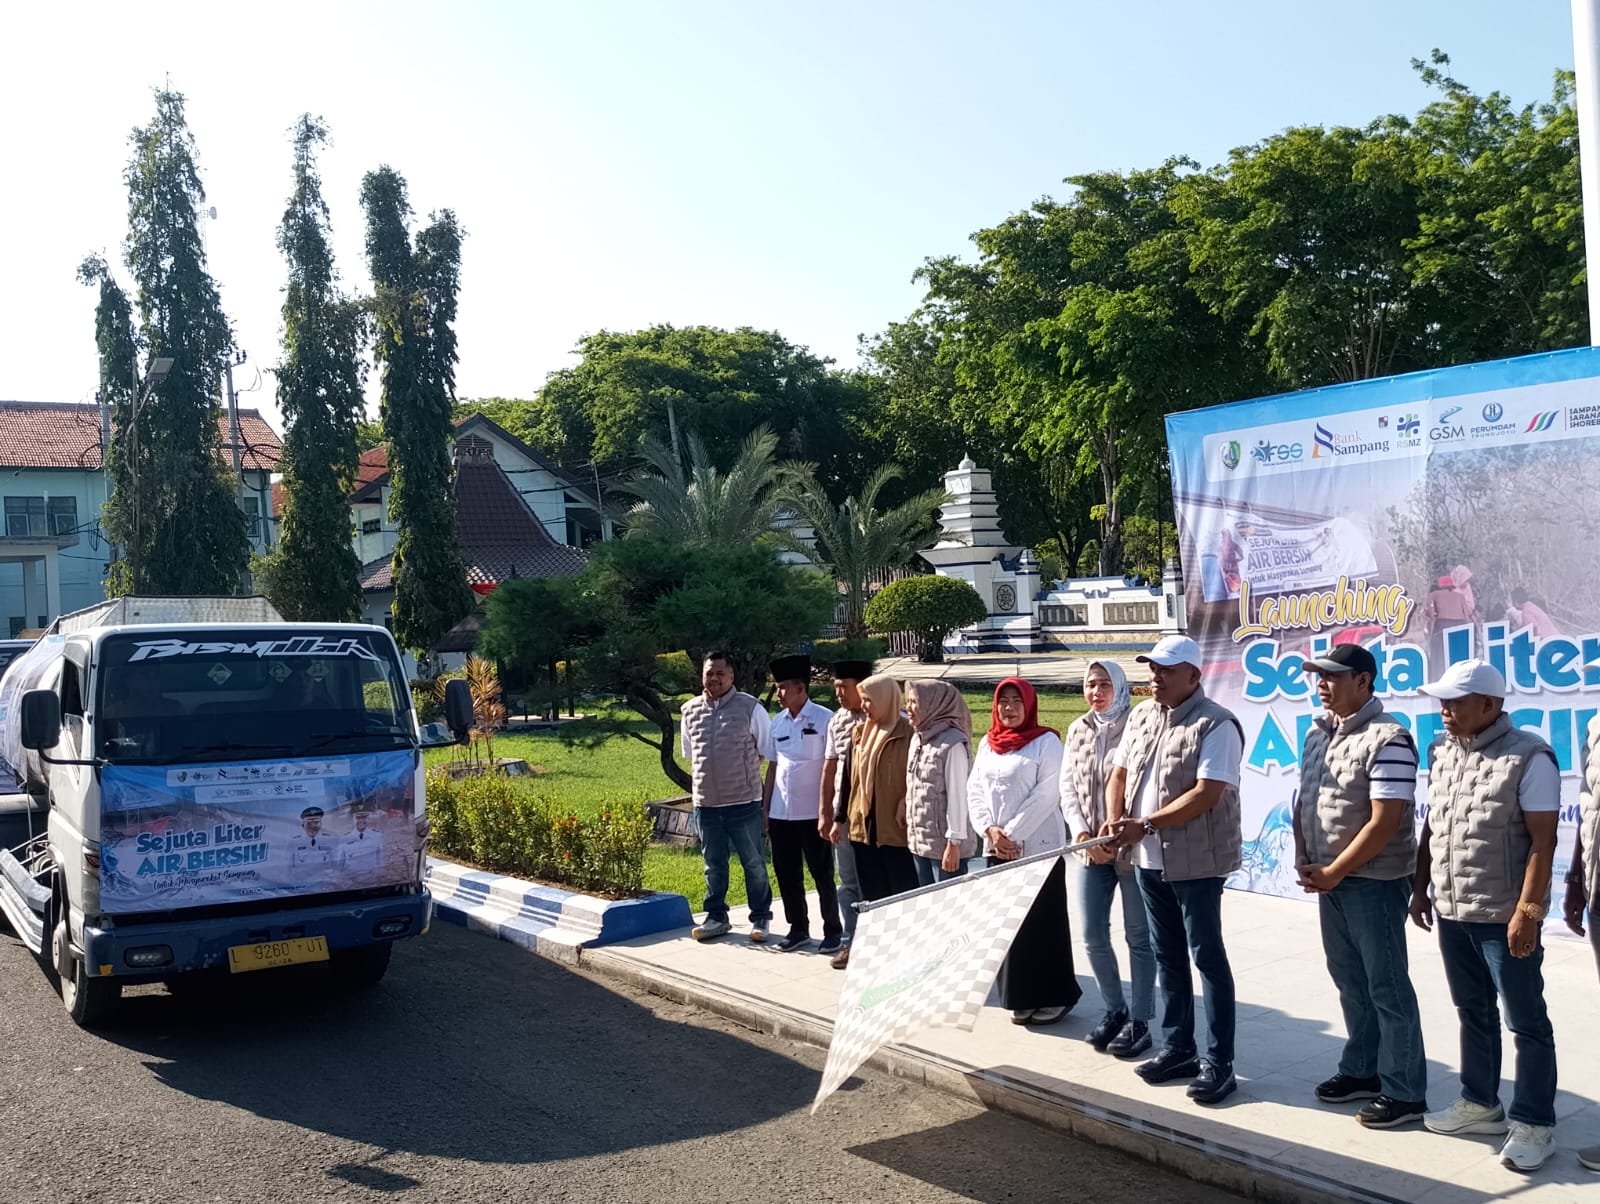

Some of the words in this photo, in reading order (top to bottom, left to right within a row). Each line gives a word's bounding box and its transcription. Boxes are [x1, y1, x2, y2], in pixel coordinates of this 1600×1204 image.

[1334, 430, 1362, 444] Bank
[1429, 424, 1465, 440] GSM
[1471, 423, 1516, 434] PERUMDAM
[1334, 440, 1390, 456] Sampang
[1397, 438, 1421, 449] RSMZ
[1247, 550, 1272, 571] AIR
[1272, 548, 1312, 566] BERSIH
[1233, 575, 1413, 641] Launching
[137, 830, 208, 852] Sejuta
[214, 823, 265, 844] Liter
[137, 854, 183, 877] AIR
[187, 842, 267, 871] BERSIH
[231, 949, 240, 963] L
[254, 943, 290, 959] 9260
